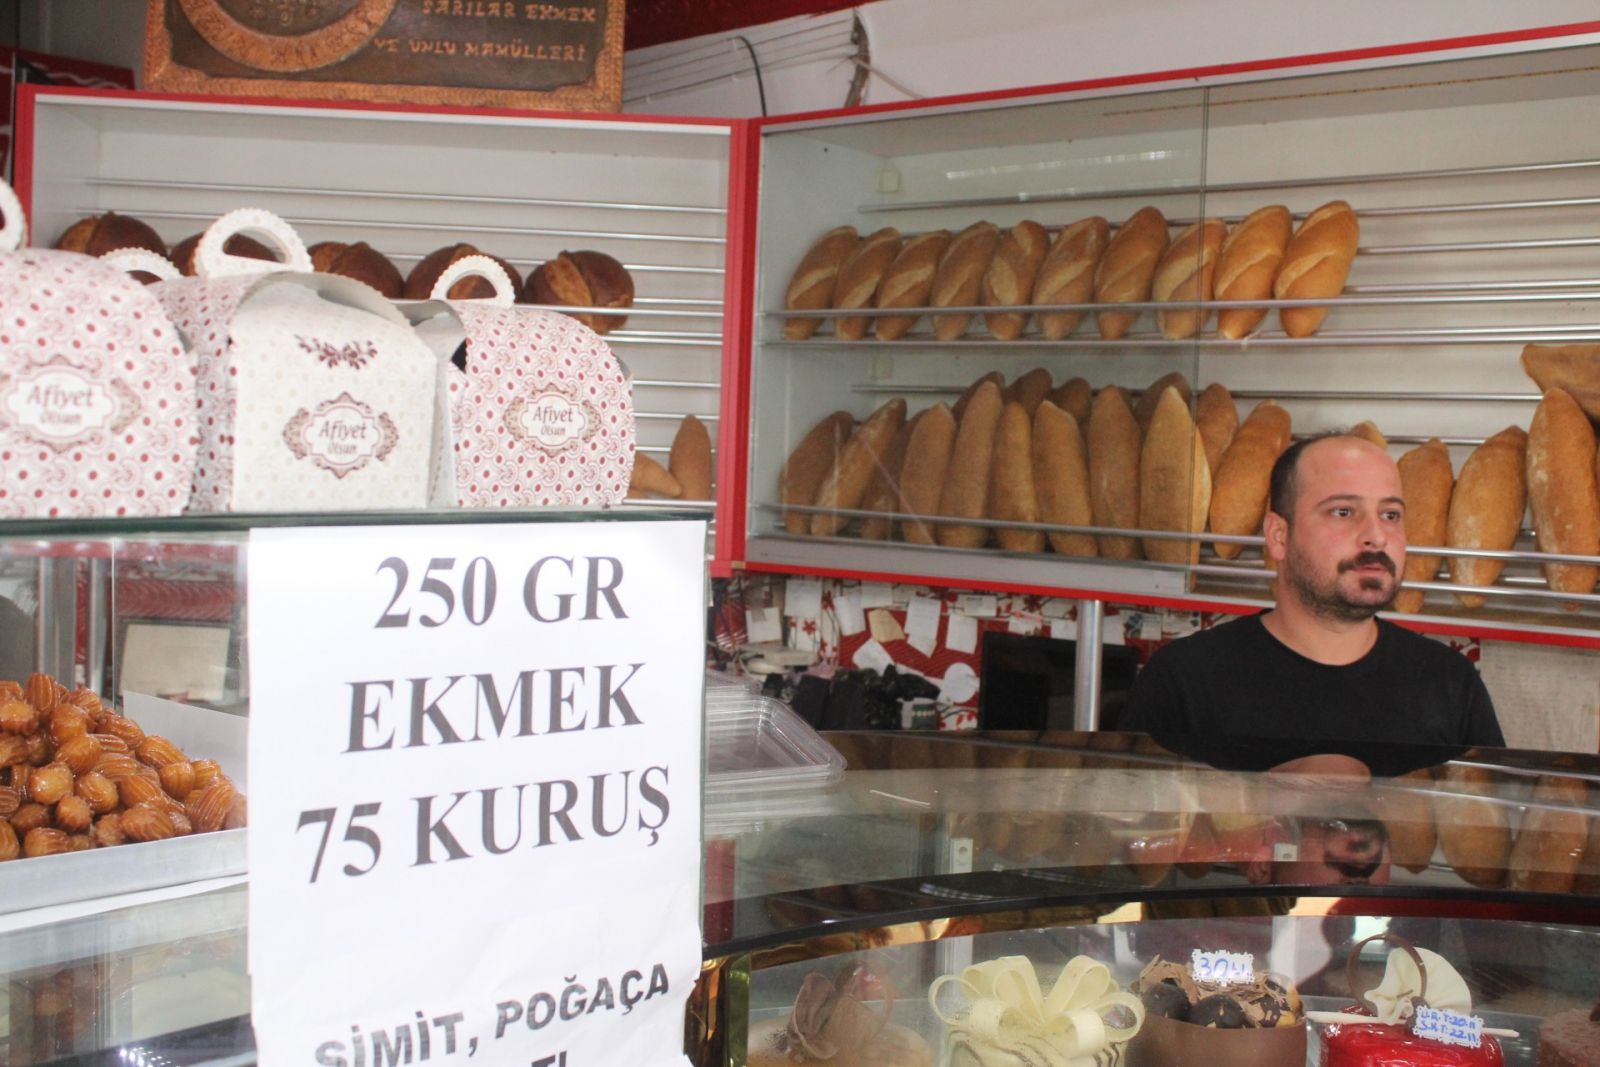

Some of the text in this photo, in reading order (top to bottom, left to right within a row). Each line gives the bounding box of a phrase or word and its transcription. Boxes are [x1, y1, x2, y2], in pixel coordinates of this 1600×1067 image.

[422, 0, 596, 22] SARILAR EKMEK
[373, 38, 399, 52] VE
[26, 385, 94, 409] Afiyet
[532, 405, 574, 424] Afiyet
[319, 420, 367, 441] Afiyet
[540, 425, 566, 436] Olsun
[373, 555, 630, 628] 250 GR
[340, 662, 646, 754] EKMEK
[296, 764, 670, 884] 75 KURUŞ
[314, 963, 670, 1067] SİMİT, POĞAÇA
